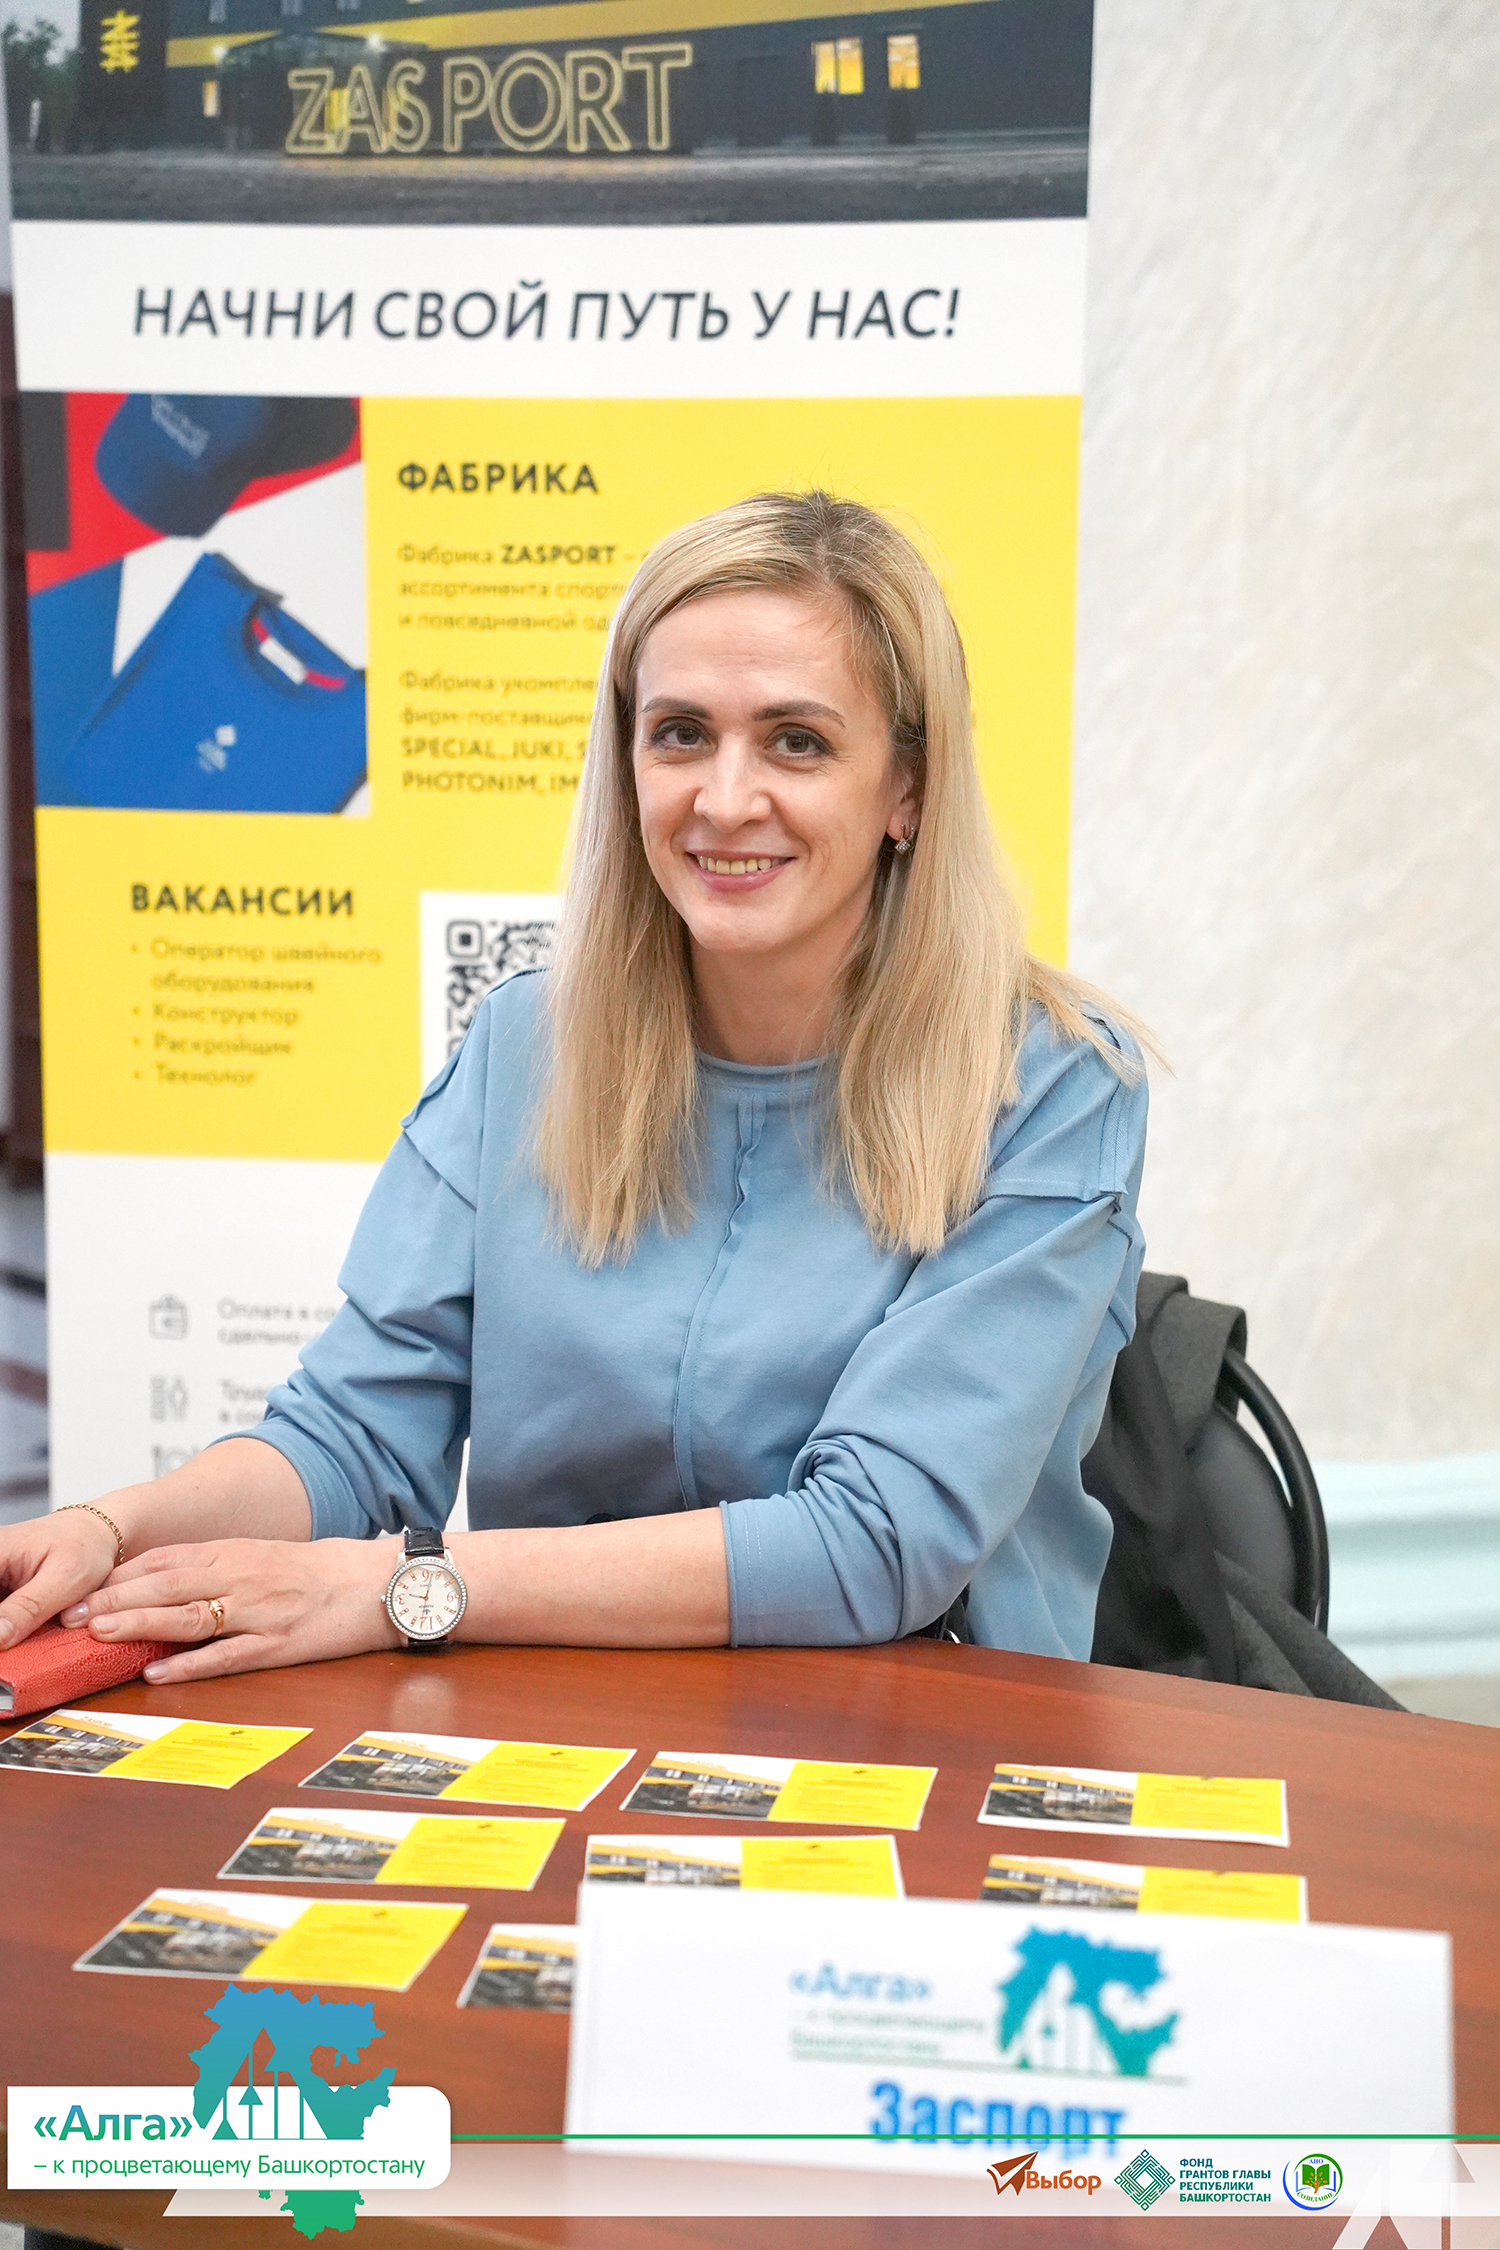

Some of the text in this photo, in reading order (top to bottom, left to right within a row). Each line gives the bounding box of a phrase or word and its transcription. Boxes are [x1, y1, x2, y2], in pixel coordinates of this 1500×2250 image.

[134, 280, 960, 341] НАЧНИ СВОЙ ПУТЬ У НАС!
[398, 461, 599, 495] ФАБРИКА
[398, 542, 494, 568] Фабрика
[500, 544, 618, 566] ZASPORT
[398, 581, 626, 602] ассортимента спорт
[399, 668, 599, 697] Фабрика укомпле
[132, 882, 354, 917] ВАКАНСИИ
[149, 936, 267, 964] Оператор
[153, 1001, 300, 1028] Конструктор
[870, 2078, 1127, 2160] Заспорт
